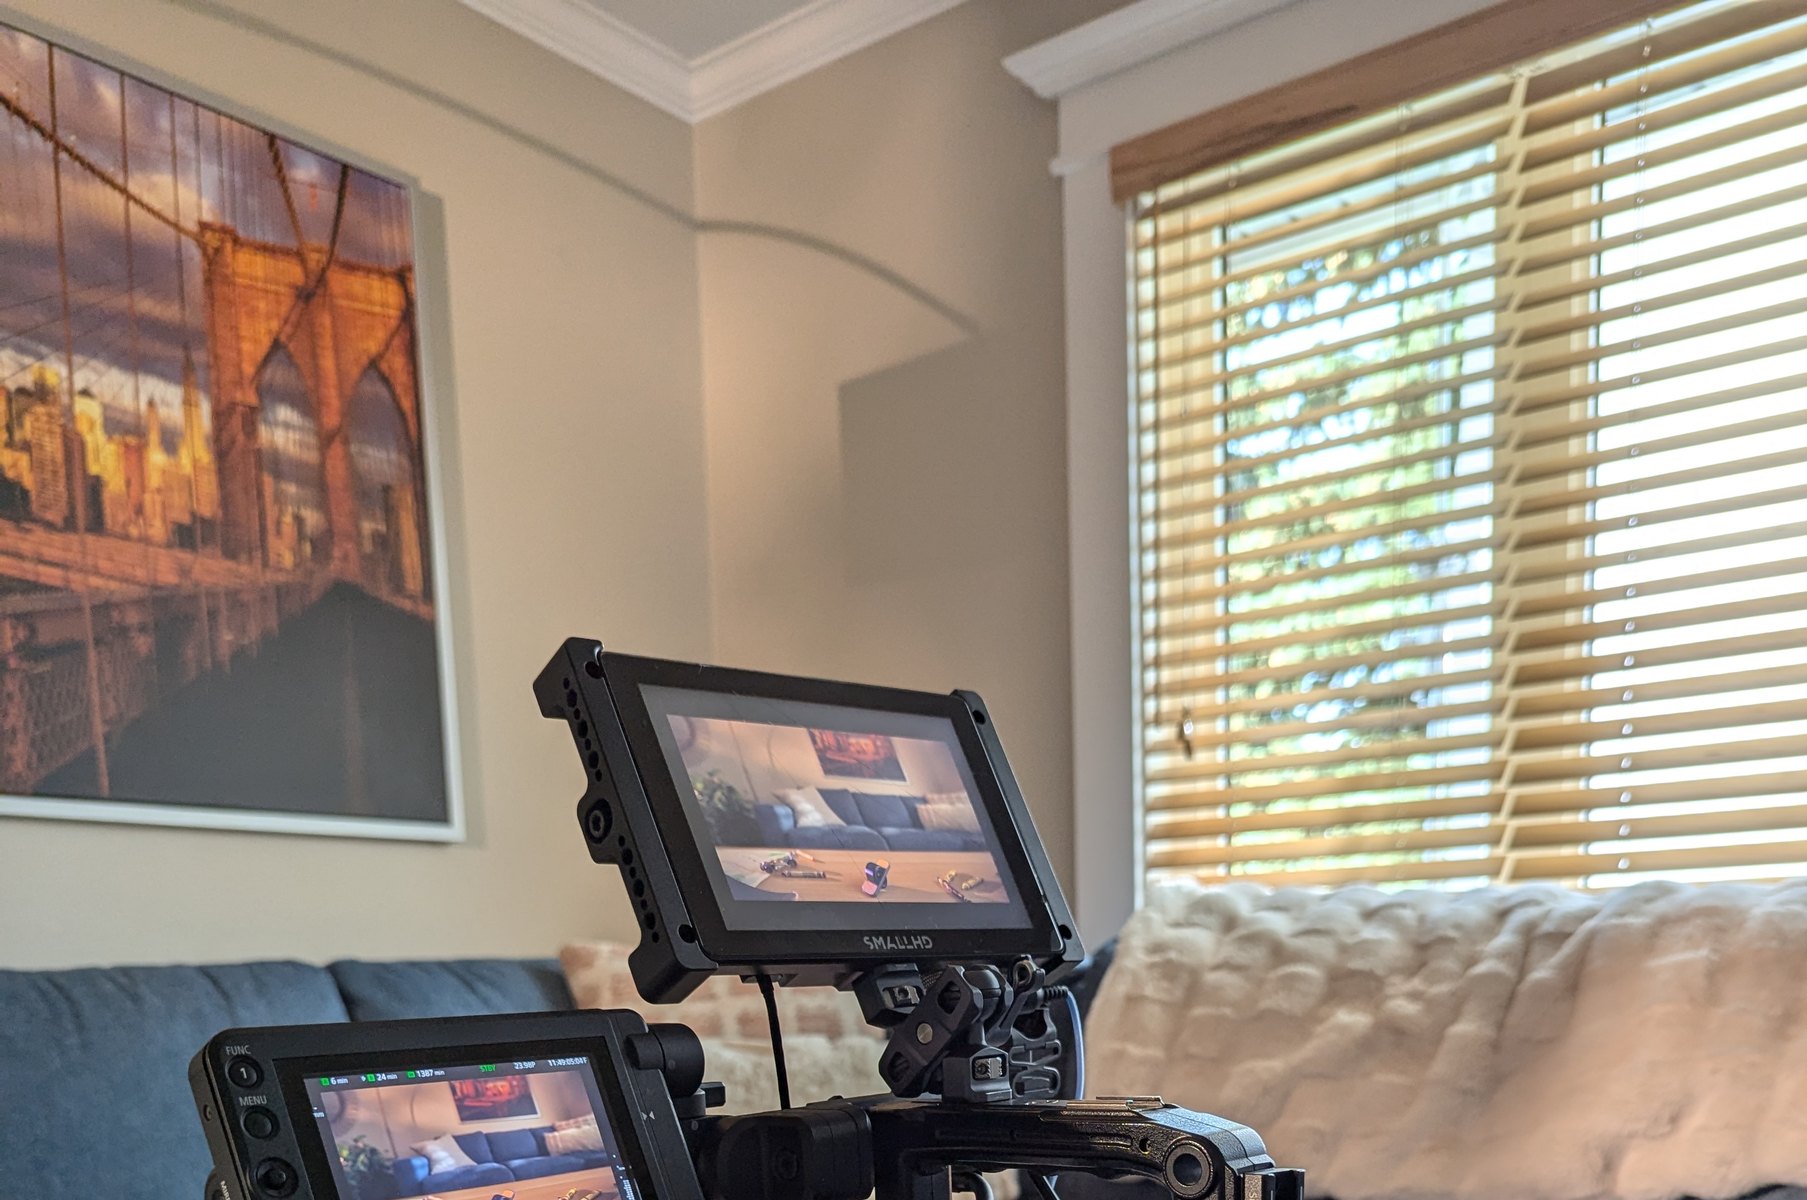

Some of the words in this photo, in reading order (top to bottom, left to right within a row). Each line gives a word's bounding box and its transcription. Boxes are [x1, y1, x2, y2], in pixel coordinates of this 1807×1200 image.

[863, 936, 933, 950] SMALLHD
[225, 1045, 252, 1055] FUNC
[242, 1067, 251, 1079] 1
[376, 1073, 386, 1081] 24
[416, 1069, 433, 1078] 1387
[330, 1077, 336, 1085] 6
[239, 1095, 268, 1106] MENU
